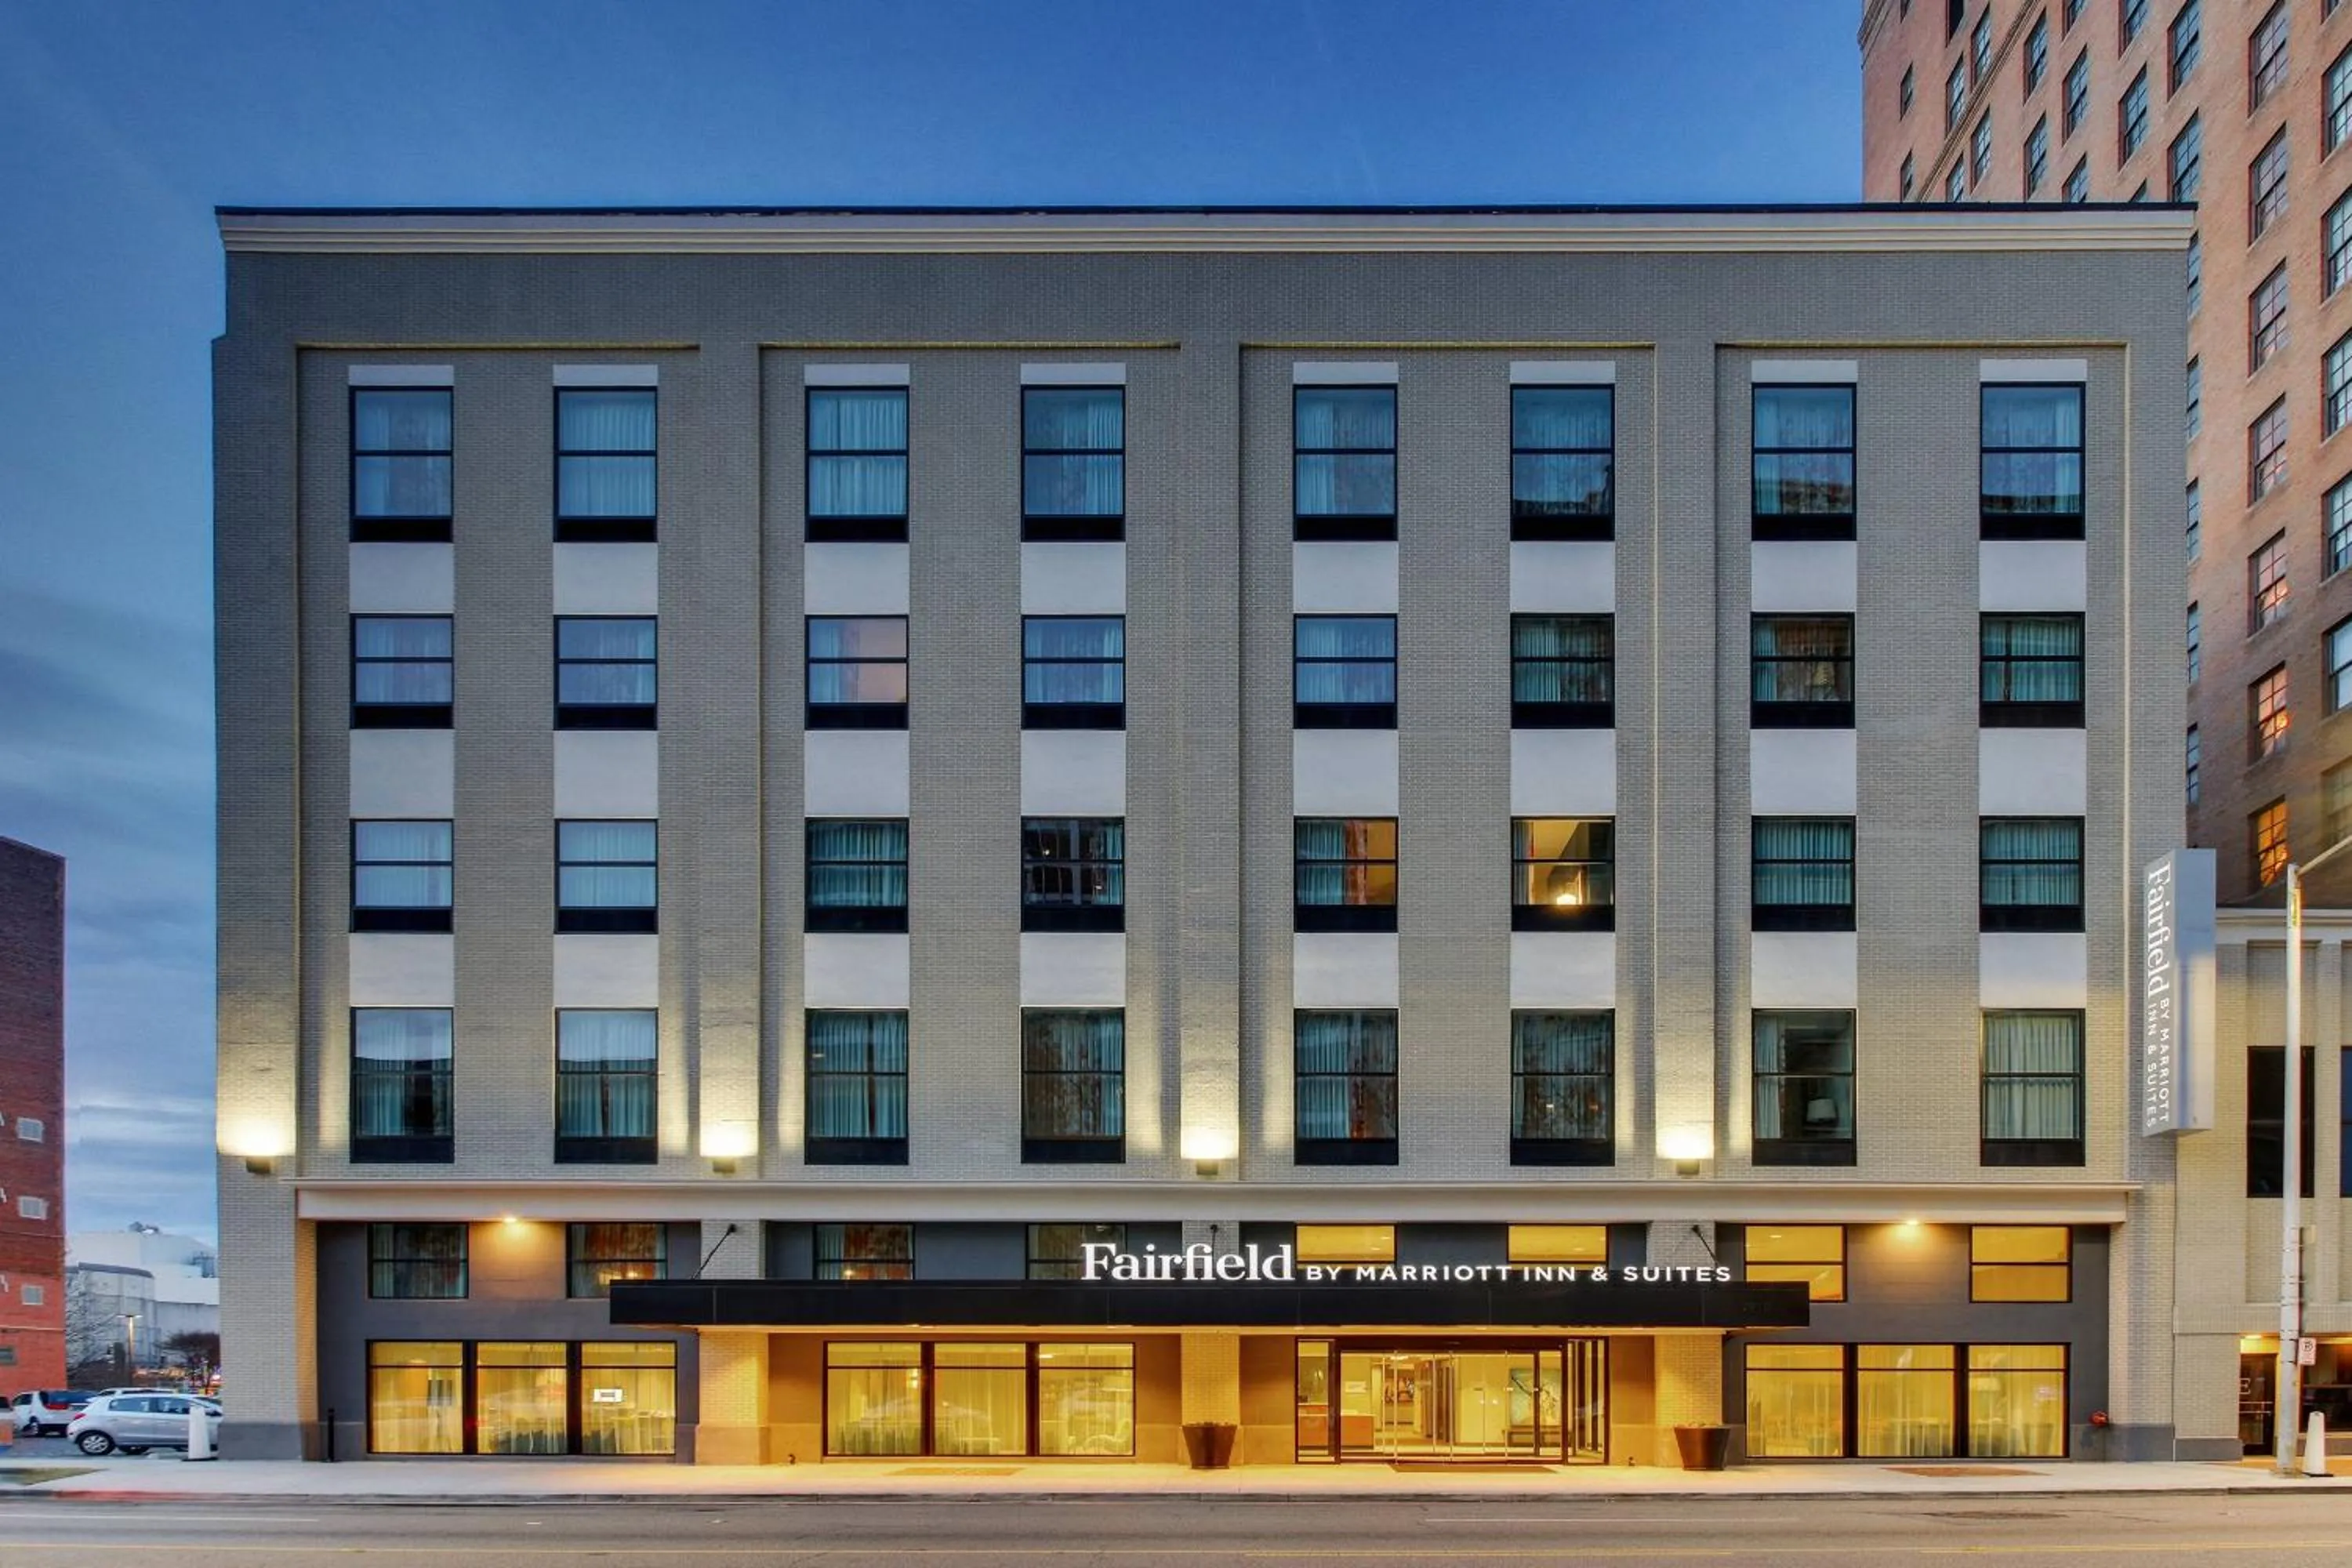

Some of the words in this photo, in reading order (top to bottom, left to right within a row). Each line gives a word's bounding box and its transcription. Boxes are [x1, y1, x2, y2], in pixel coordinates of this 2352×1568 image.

[2147, 861, 2171, 997] Fairfield
[2147, 1003, 2157, 1036] INN
[2160, 997, 2169, 1018] BY
[2147, 1044, 2157, 1054] &
[2158, 1028, 2169, 1122] MARRIOTT
[2146, 1062, 2157, 1128] SUITES
[1080, 1243, 1296, 1280] Fairfield
[1306, 1265, 1342, 1280] BY
[1356, 1265, 1512, 1280] MARRIOTT
[1523, 1265, 1576, 1280] INN
[1591, 1265, 1608, 1281] &
[1623, 1265, 1732, 1281] SUITES
